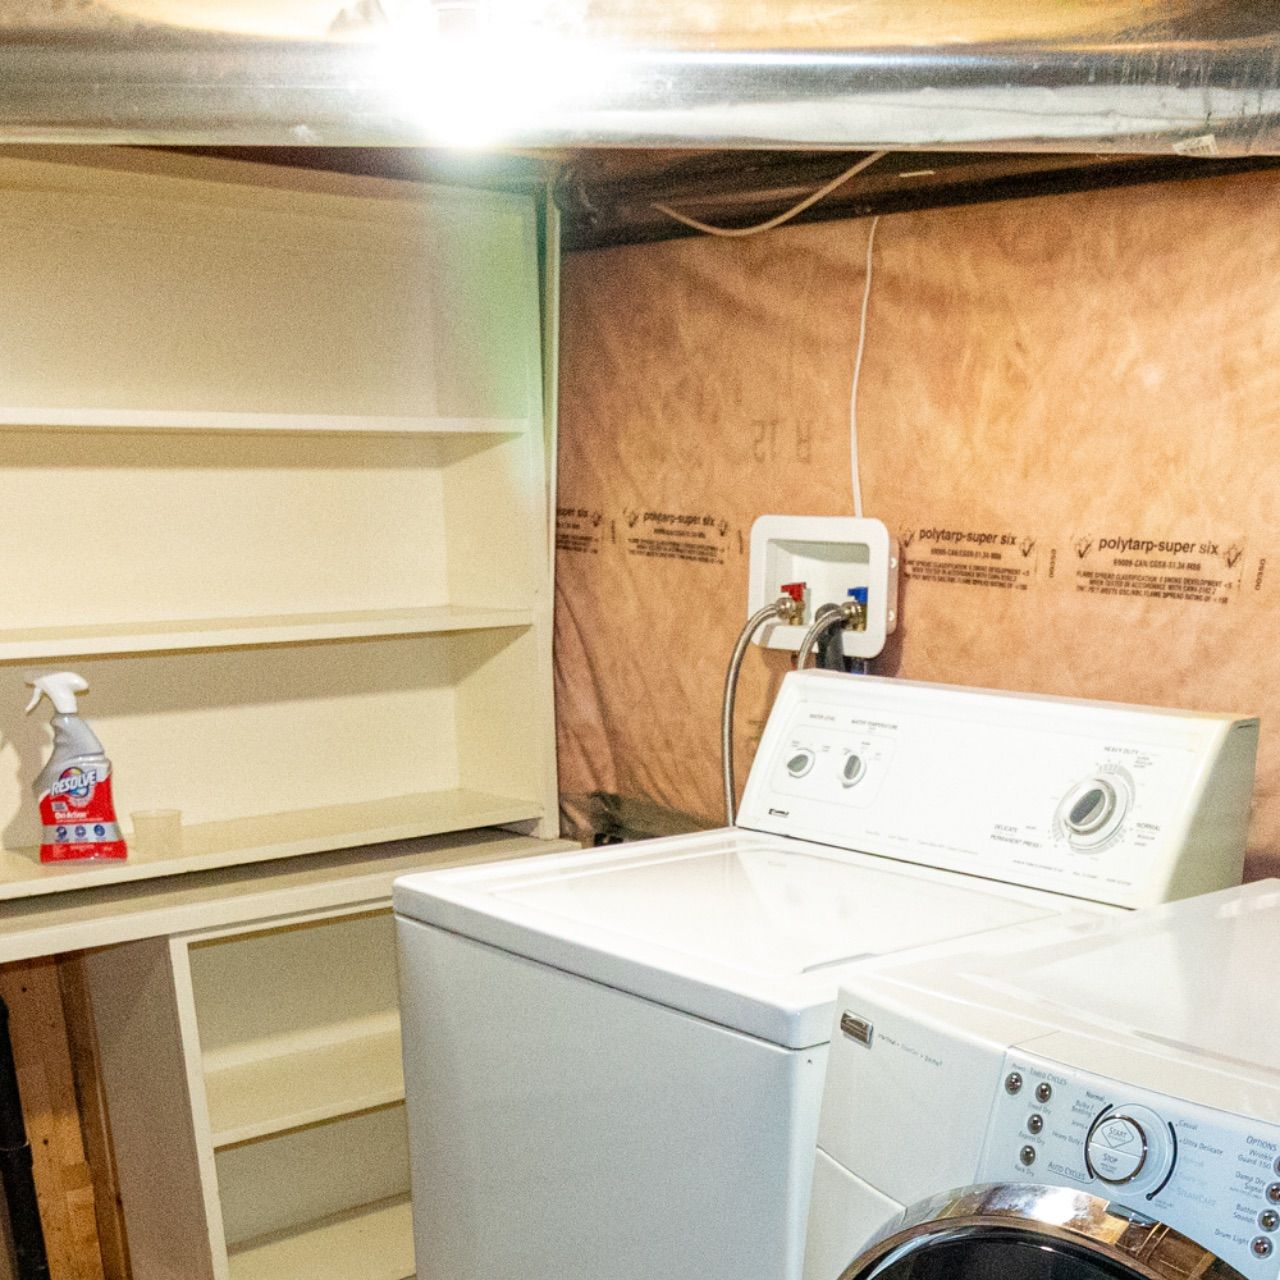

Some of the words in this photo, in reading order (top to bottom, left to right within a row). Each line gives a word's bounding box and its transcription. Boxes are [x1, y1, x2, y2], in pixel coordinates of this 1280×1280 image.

[919, 528, 999, 547] polytarp-super
[1000, 531, 1018, 546] six
[1098, 536, 1197, 556] polytarp-super
[1198, 541, 1219, 556] six
[52, 768, 97, 797] RESOLVE
[1108, 1126, 1128, 1139] START
[1199, 1142, 1224, 1155] Delicate
[1246, 1135, 1278, 1152] OPTIONS
[1103, 1153, 1119, 1163] STOP
[1238, 1154, 1257, 1166] Guard
[1249, 1149, 1274, 1162] Wrinkle
[1235, 1170, 1254, 1182] Damp
[1255, 1177, 1266, 1188] Dry
[1236, 1203, 1258, 1216] Button
[1214, 1228, 1233, 1240] Drum
[1233, 1233, 1250, 1246] Light
